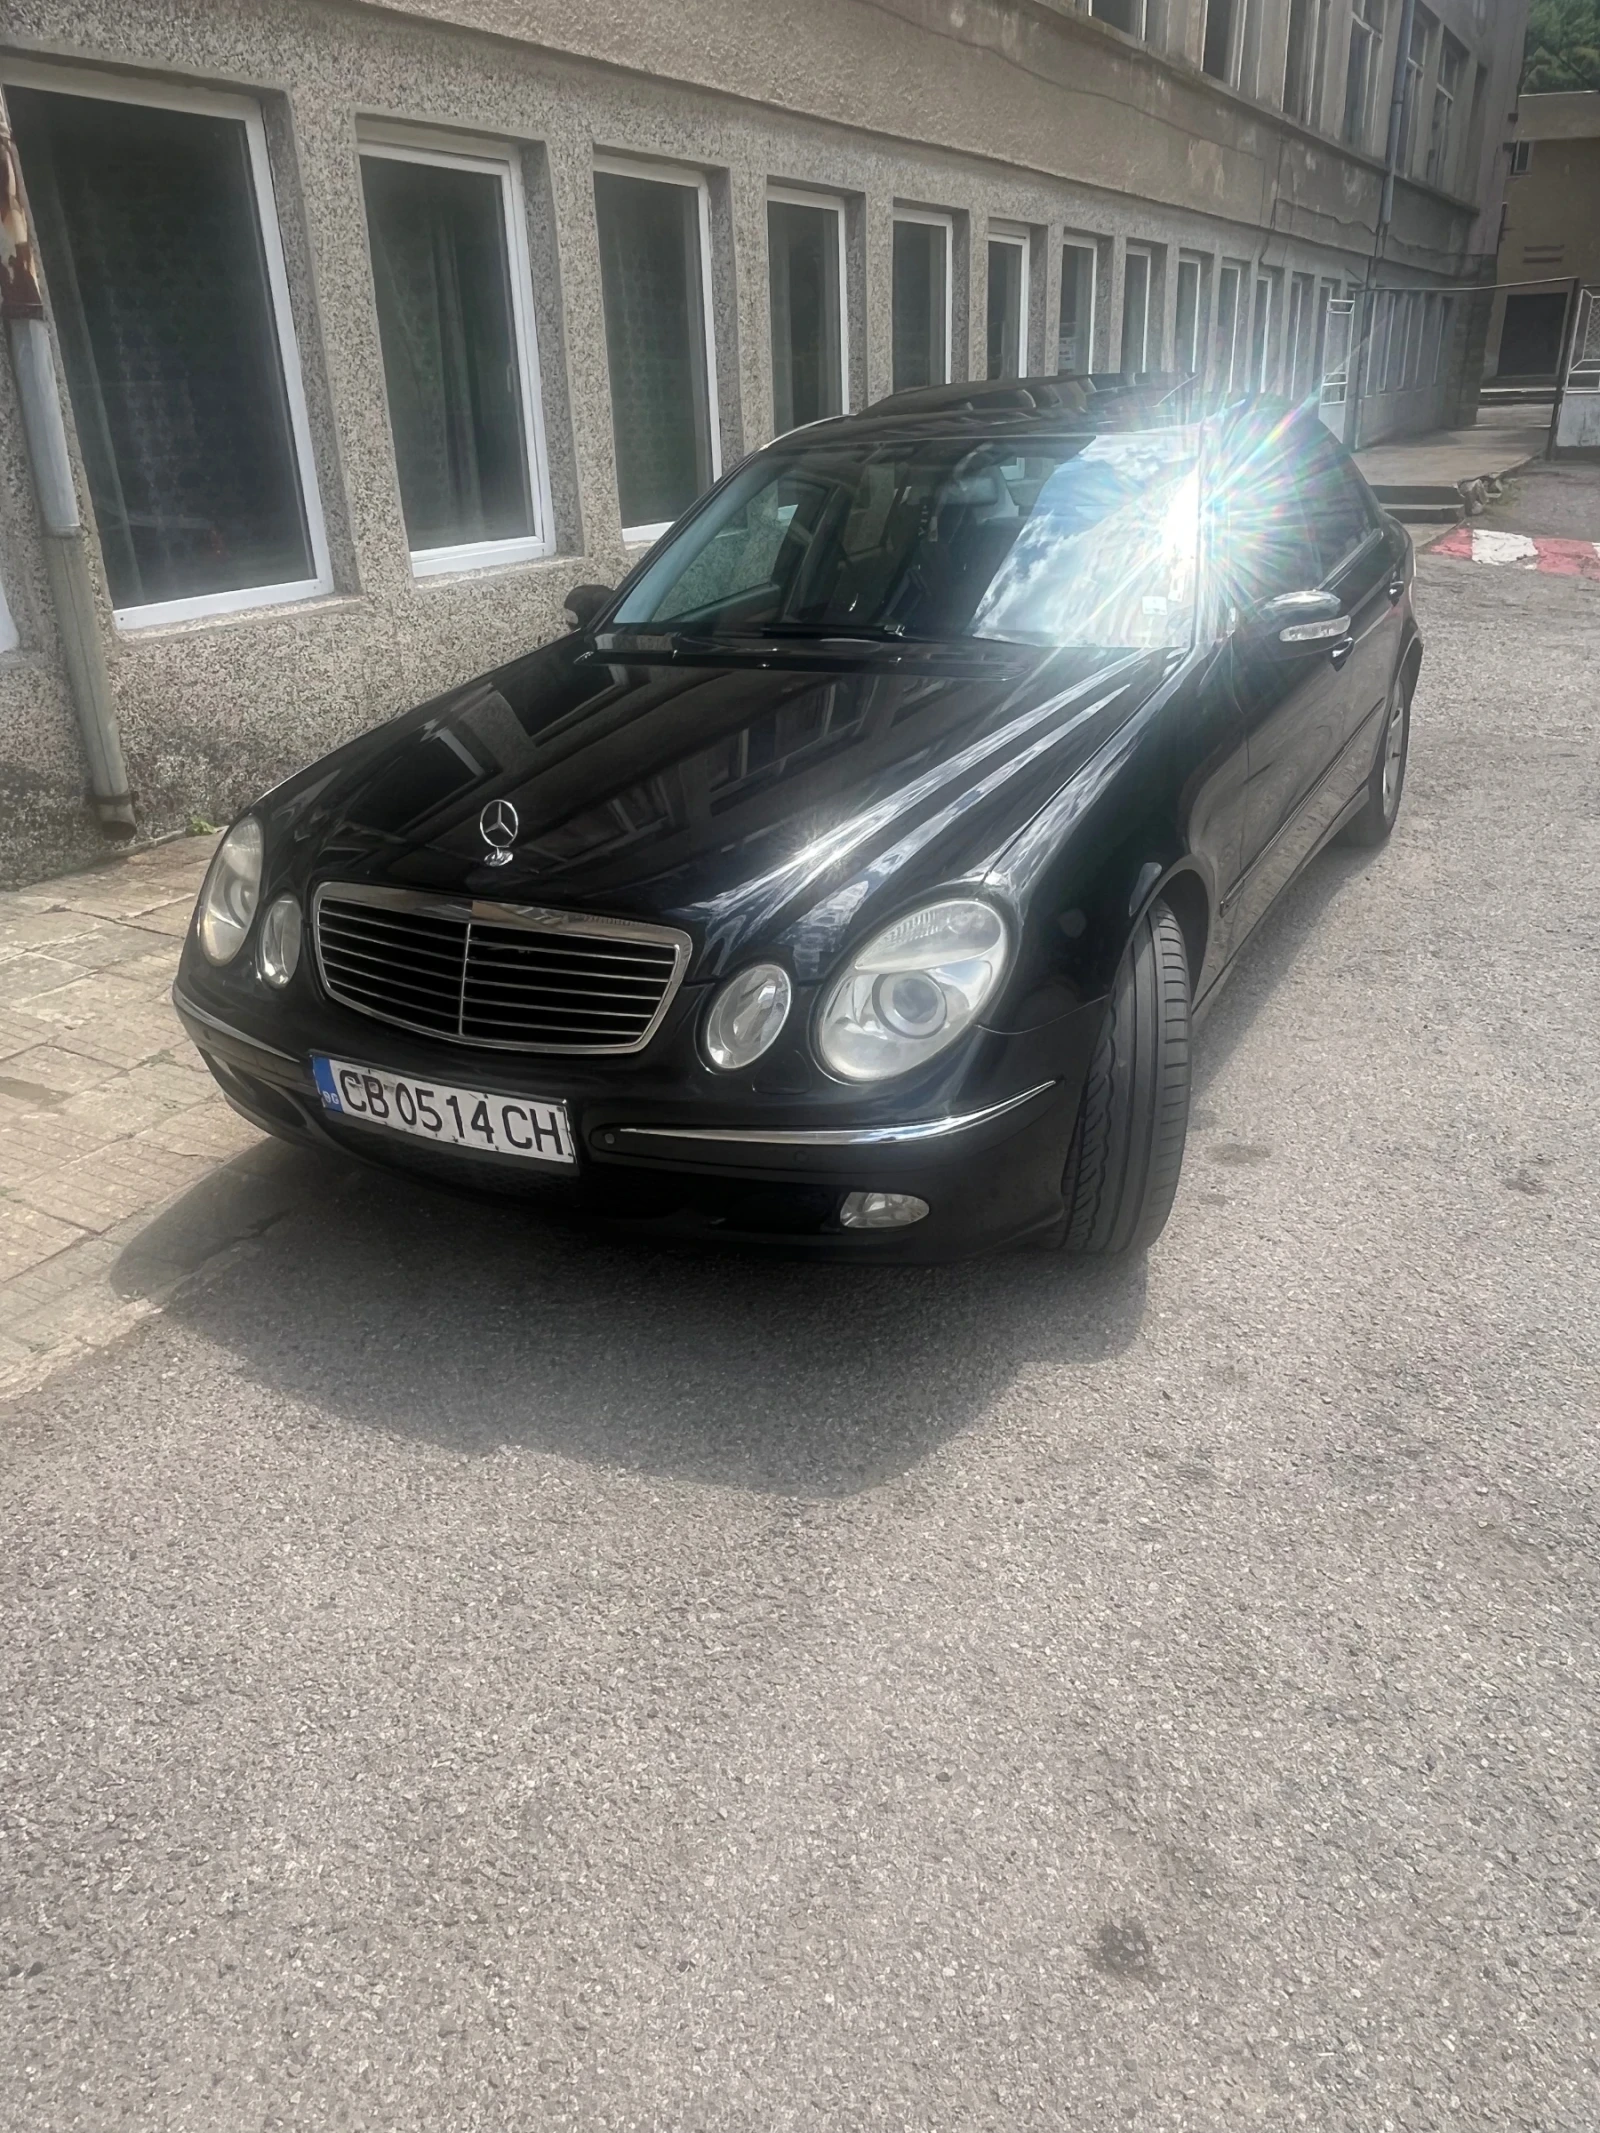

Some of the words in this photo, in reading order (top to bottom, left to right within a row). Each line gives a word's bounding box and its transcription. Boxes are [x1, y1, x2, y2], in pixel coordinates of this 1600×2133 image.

[322, 1090, 340, 1105] BG
[339, 1069, 390, 1119] CB
[395, 1082, 495, 1144] 0514
[501, 1104, 565, 1156] CH
